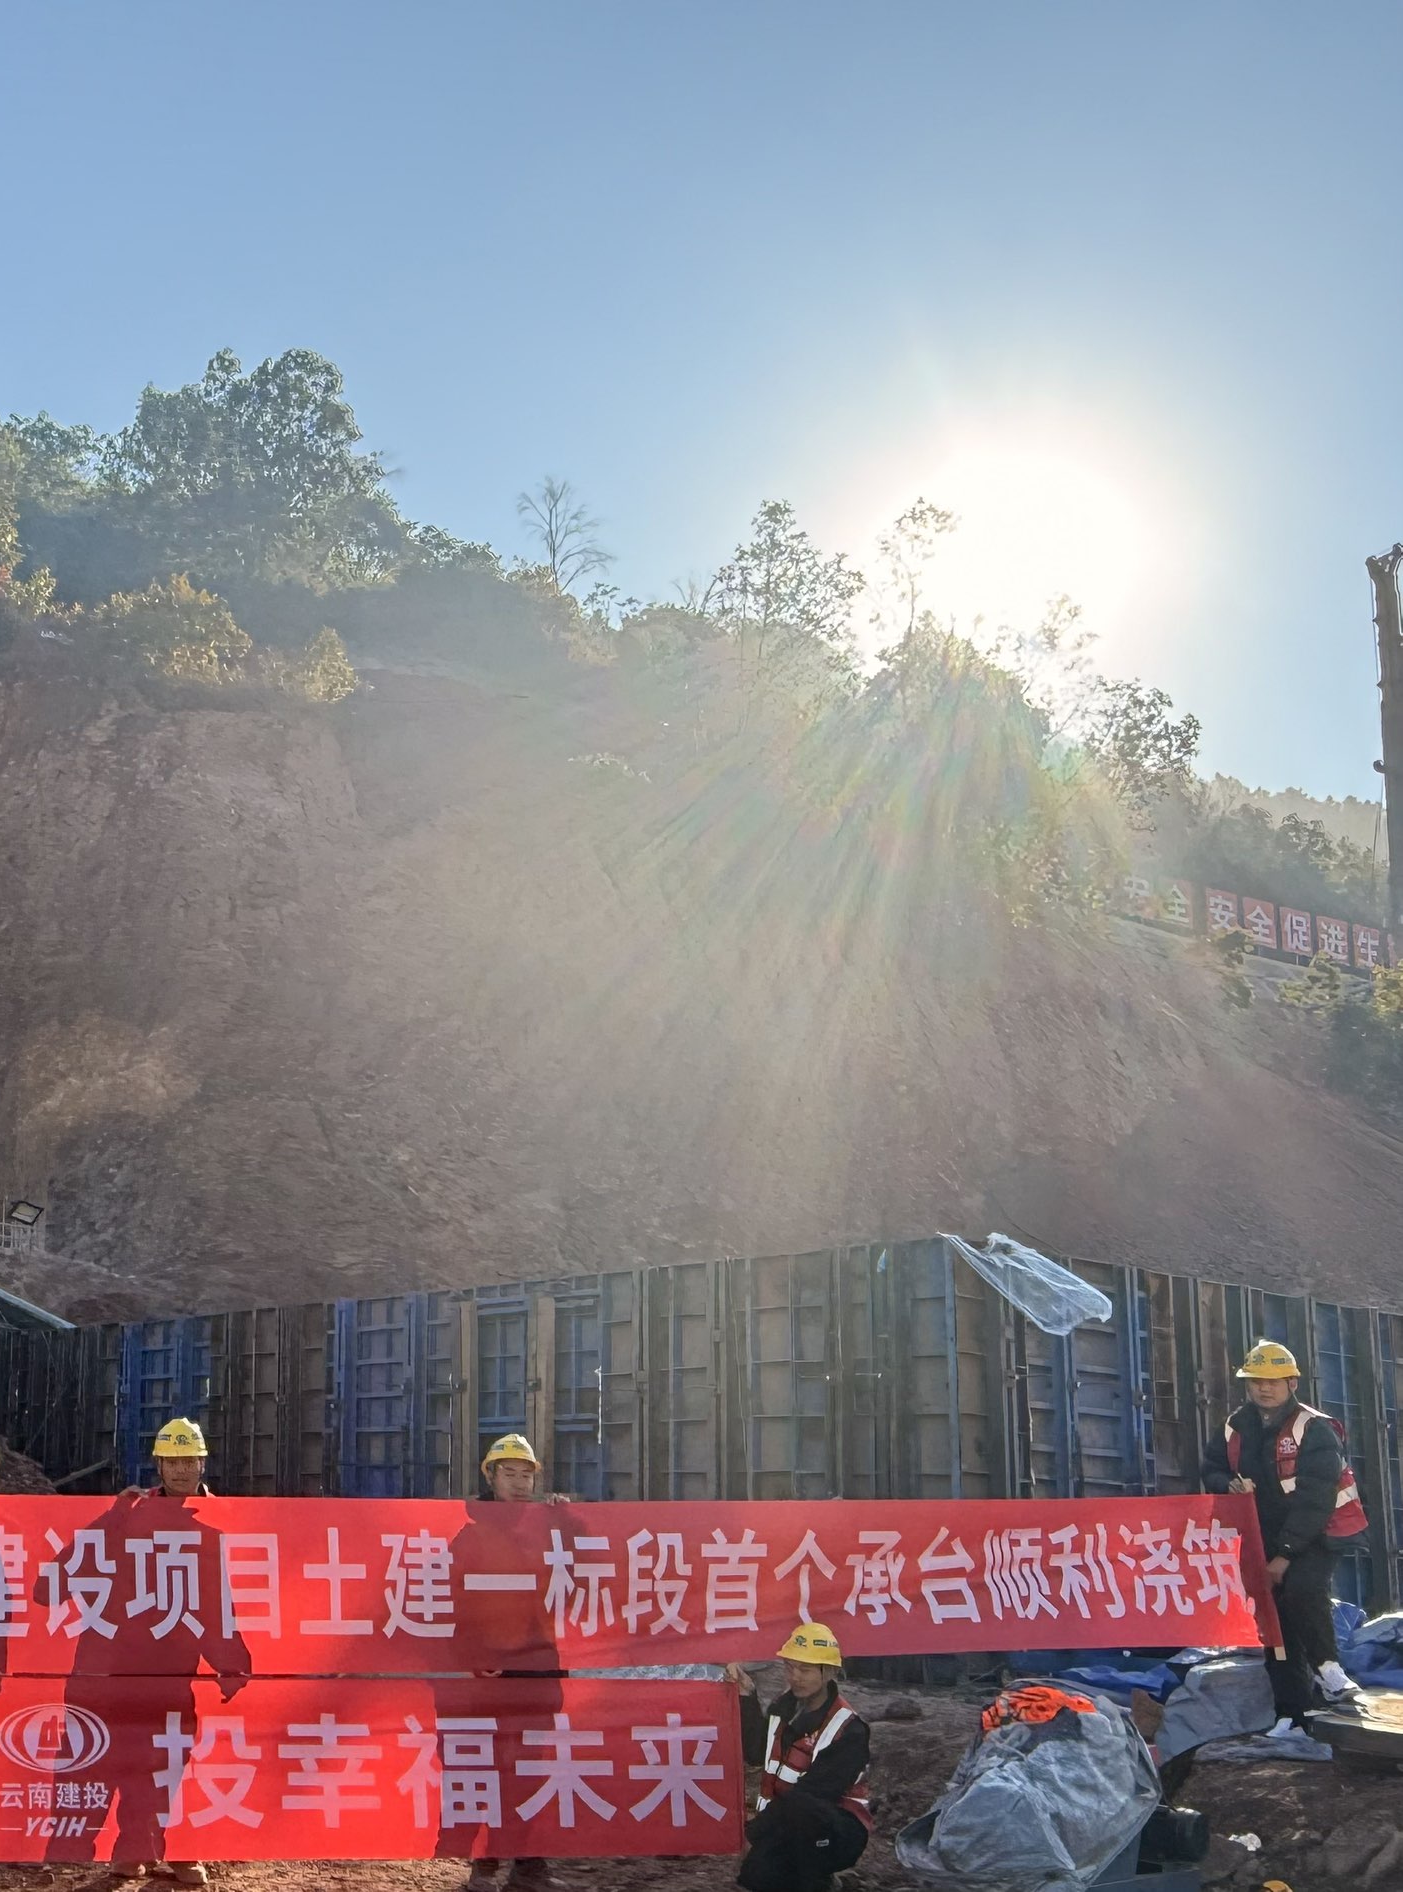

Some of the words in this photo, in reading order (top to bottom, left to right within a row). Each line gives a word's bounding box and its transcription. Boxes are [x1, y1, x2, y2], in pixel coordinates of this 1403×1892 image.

[152, 1710, 728, 1831] 投幸福未来
[0, 1781, 109, 1810] 云南建投
[25, 1816, 87, 1838] YCIH
